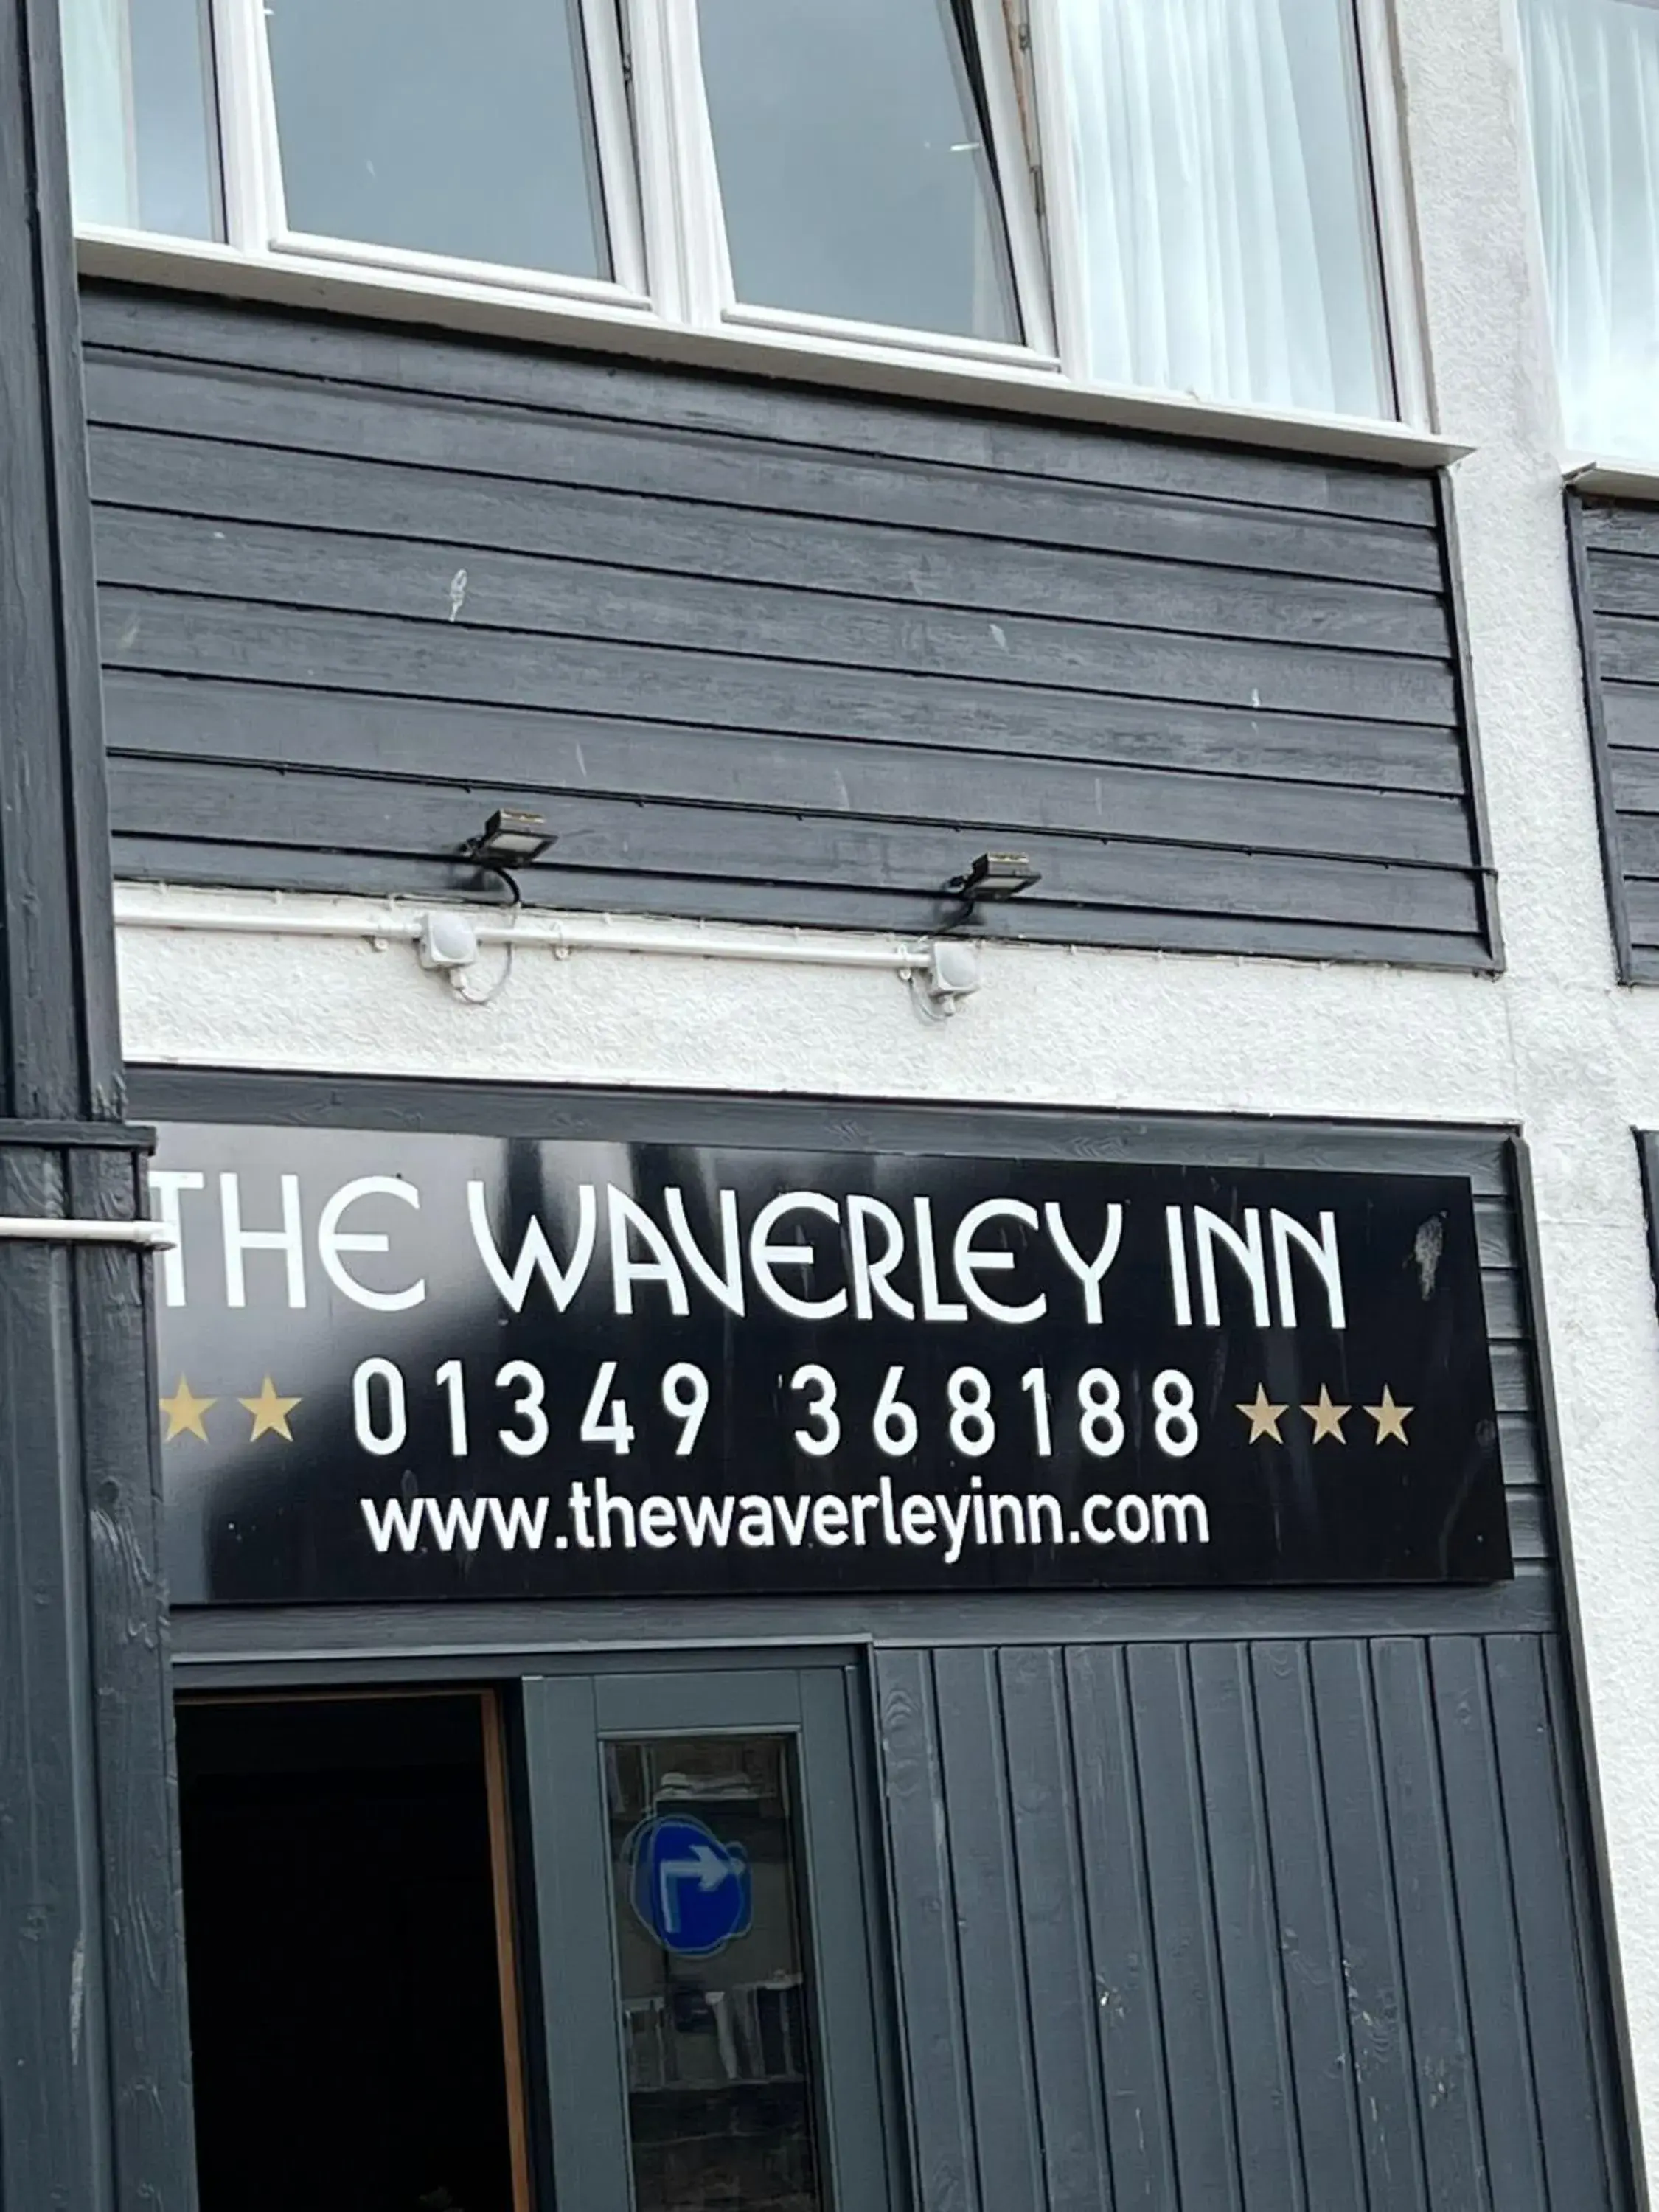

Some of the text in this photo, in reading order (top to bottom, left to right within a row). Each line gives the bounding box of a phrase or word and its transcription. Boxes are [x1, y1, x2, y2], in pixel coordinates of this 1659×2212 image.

[148, 1170, 1347, 1329] THE WAVERLEY INN
[352, 1357, 1199, 1458] 01349 368188
[359, 1475, 1210, 1564] www.thewaverleyinn.com
